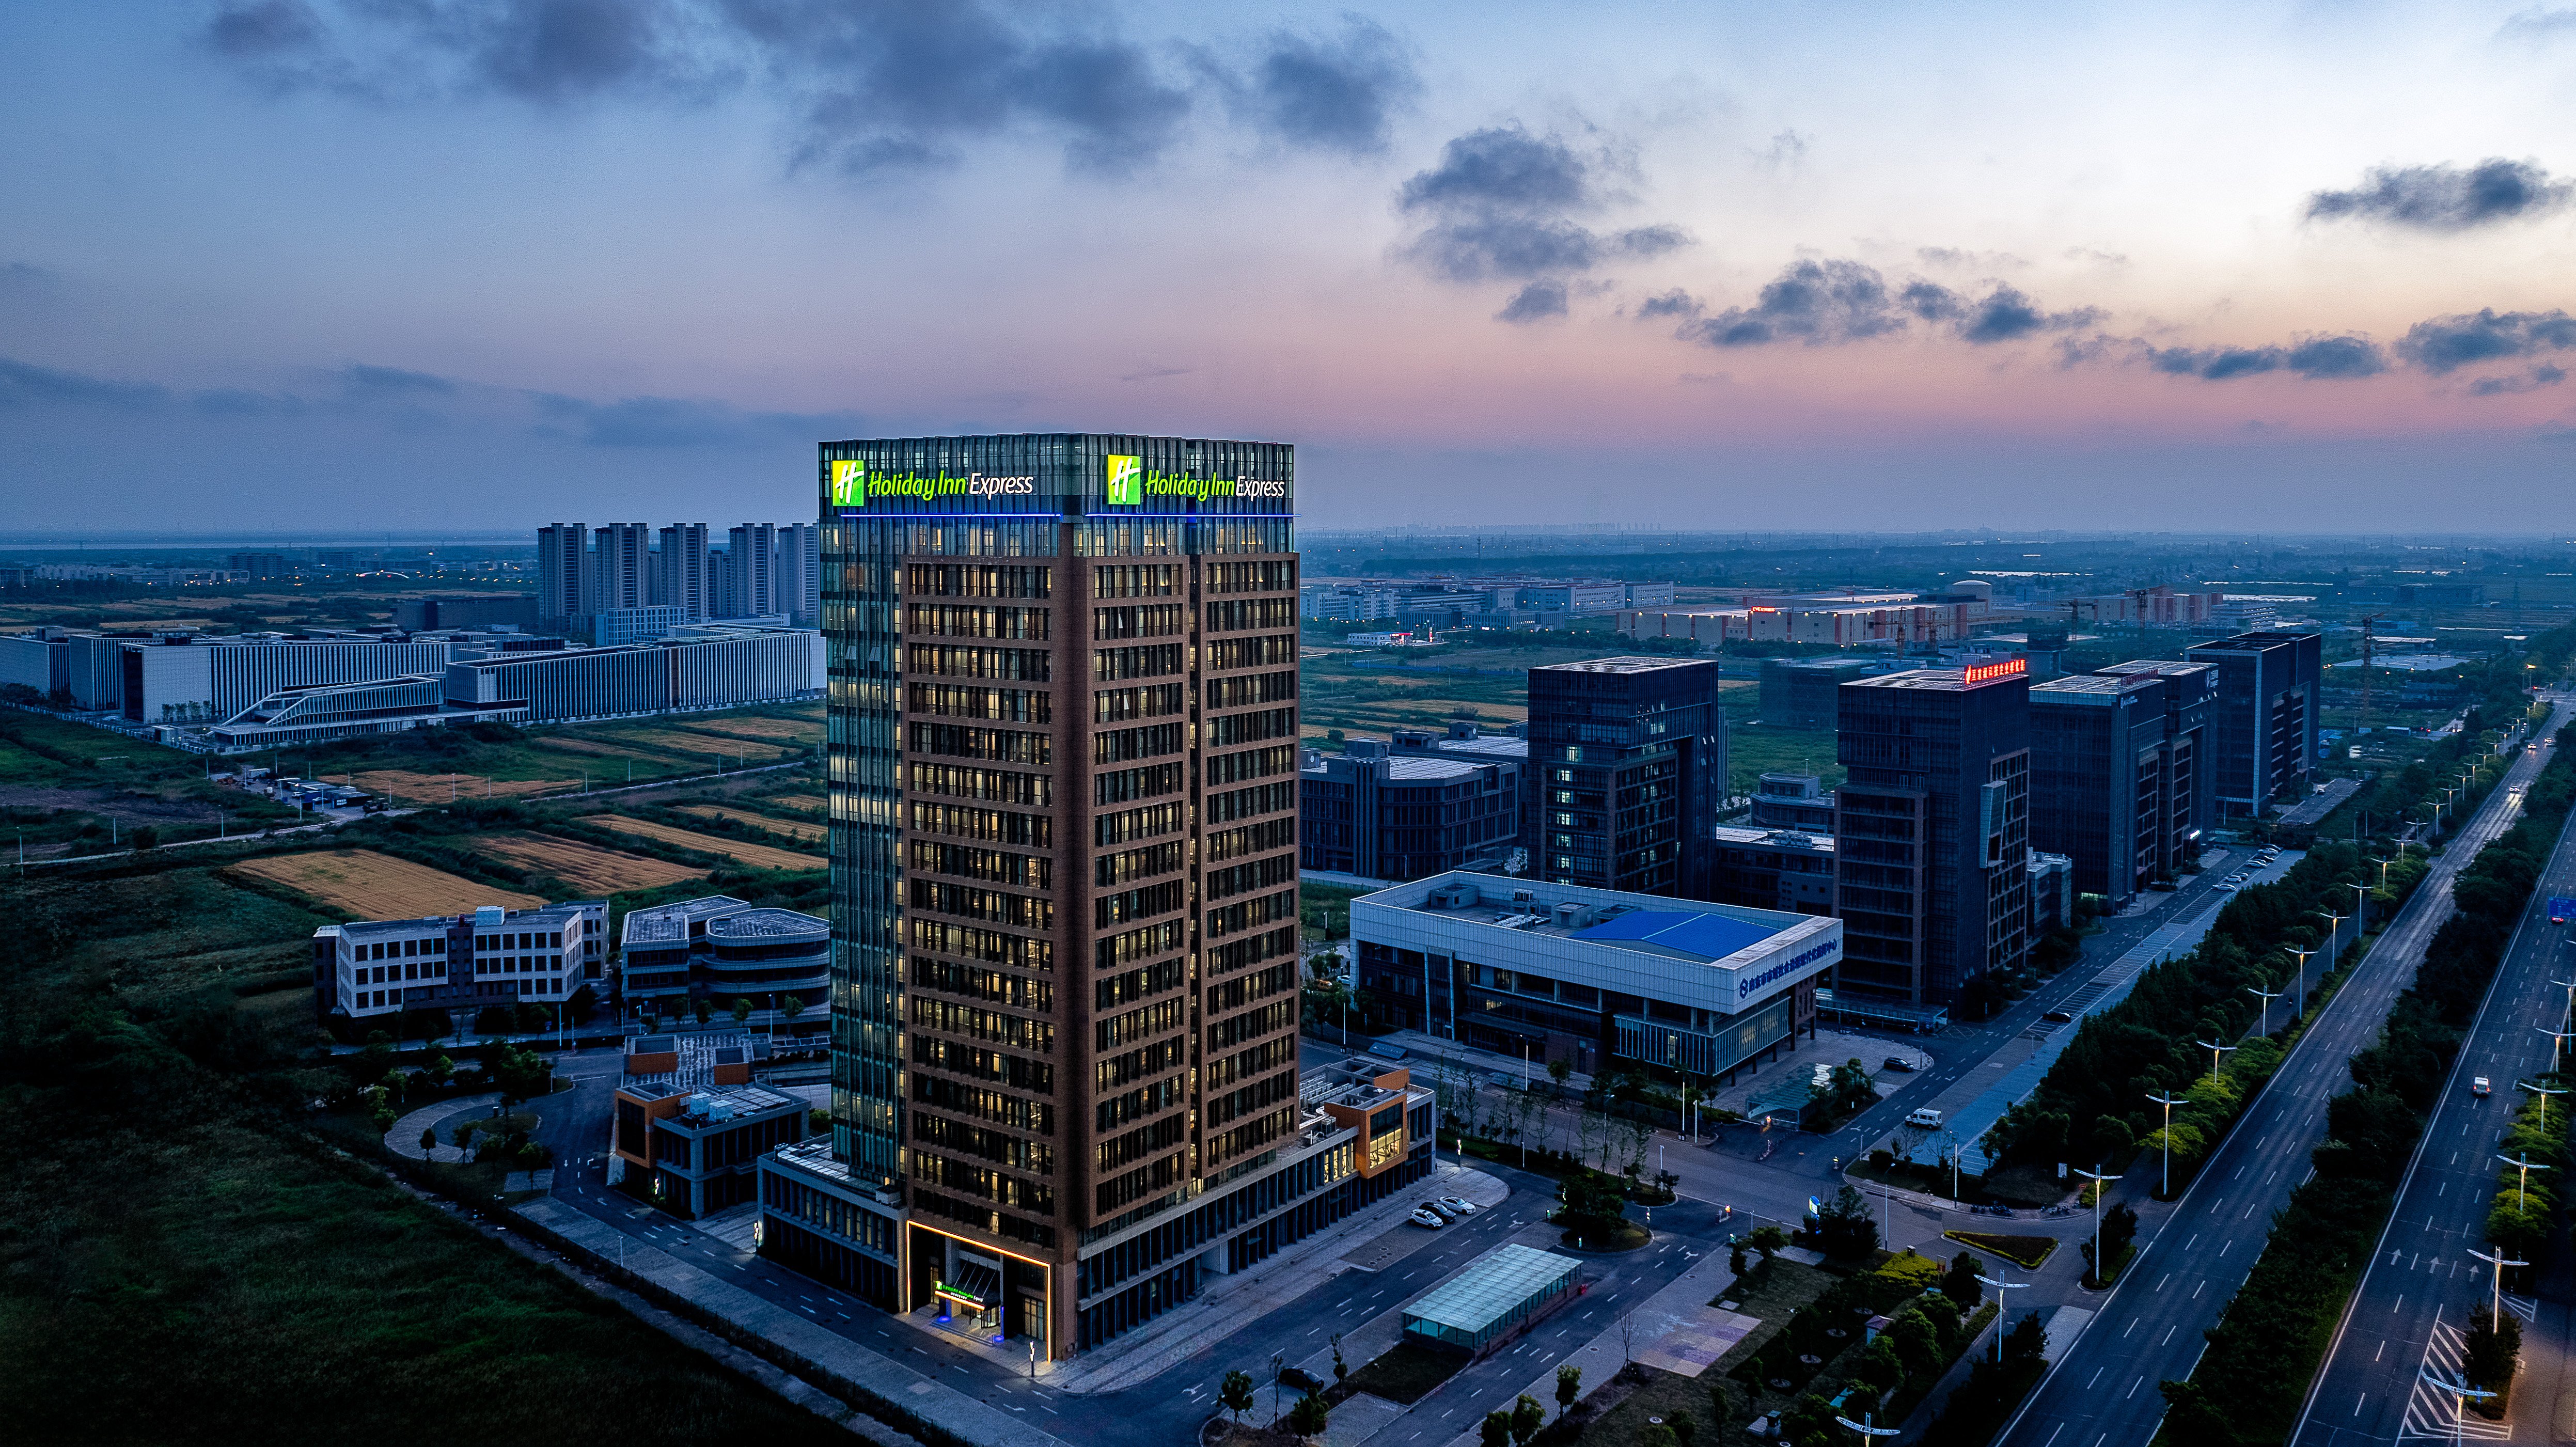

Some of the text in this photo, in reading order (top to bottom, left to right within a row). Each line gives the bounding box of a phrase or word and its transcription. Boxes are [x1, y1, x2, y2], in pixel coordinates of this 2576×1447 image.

[868, 470, 1034, 501] Holiday Inn Express
[1145, 470, 1285, 502] Holiday Inn Express
